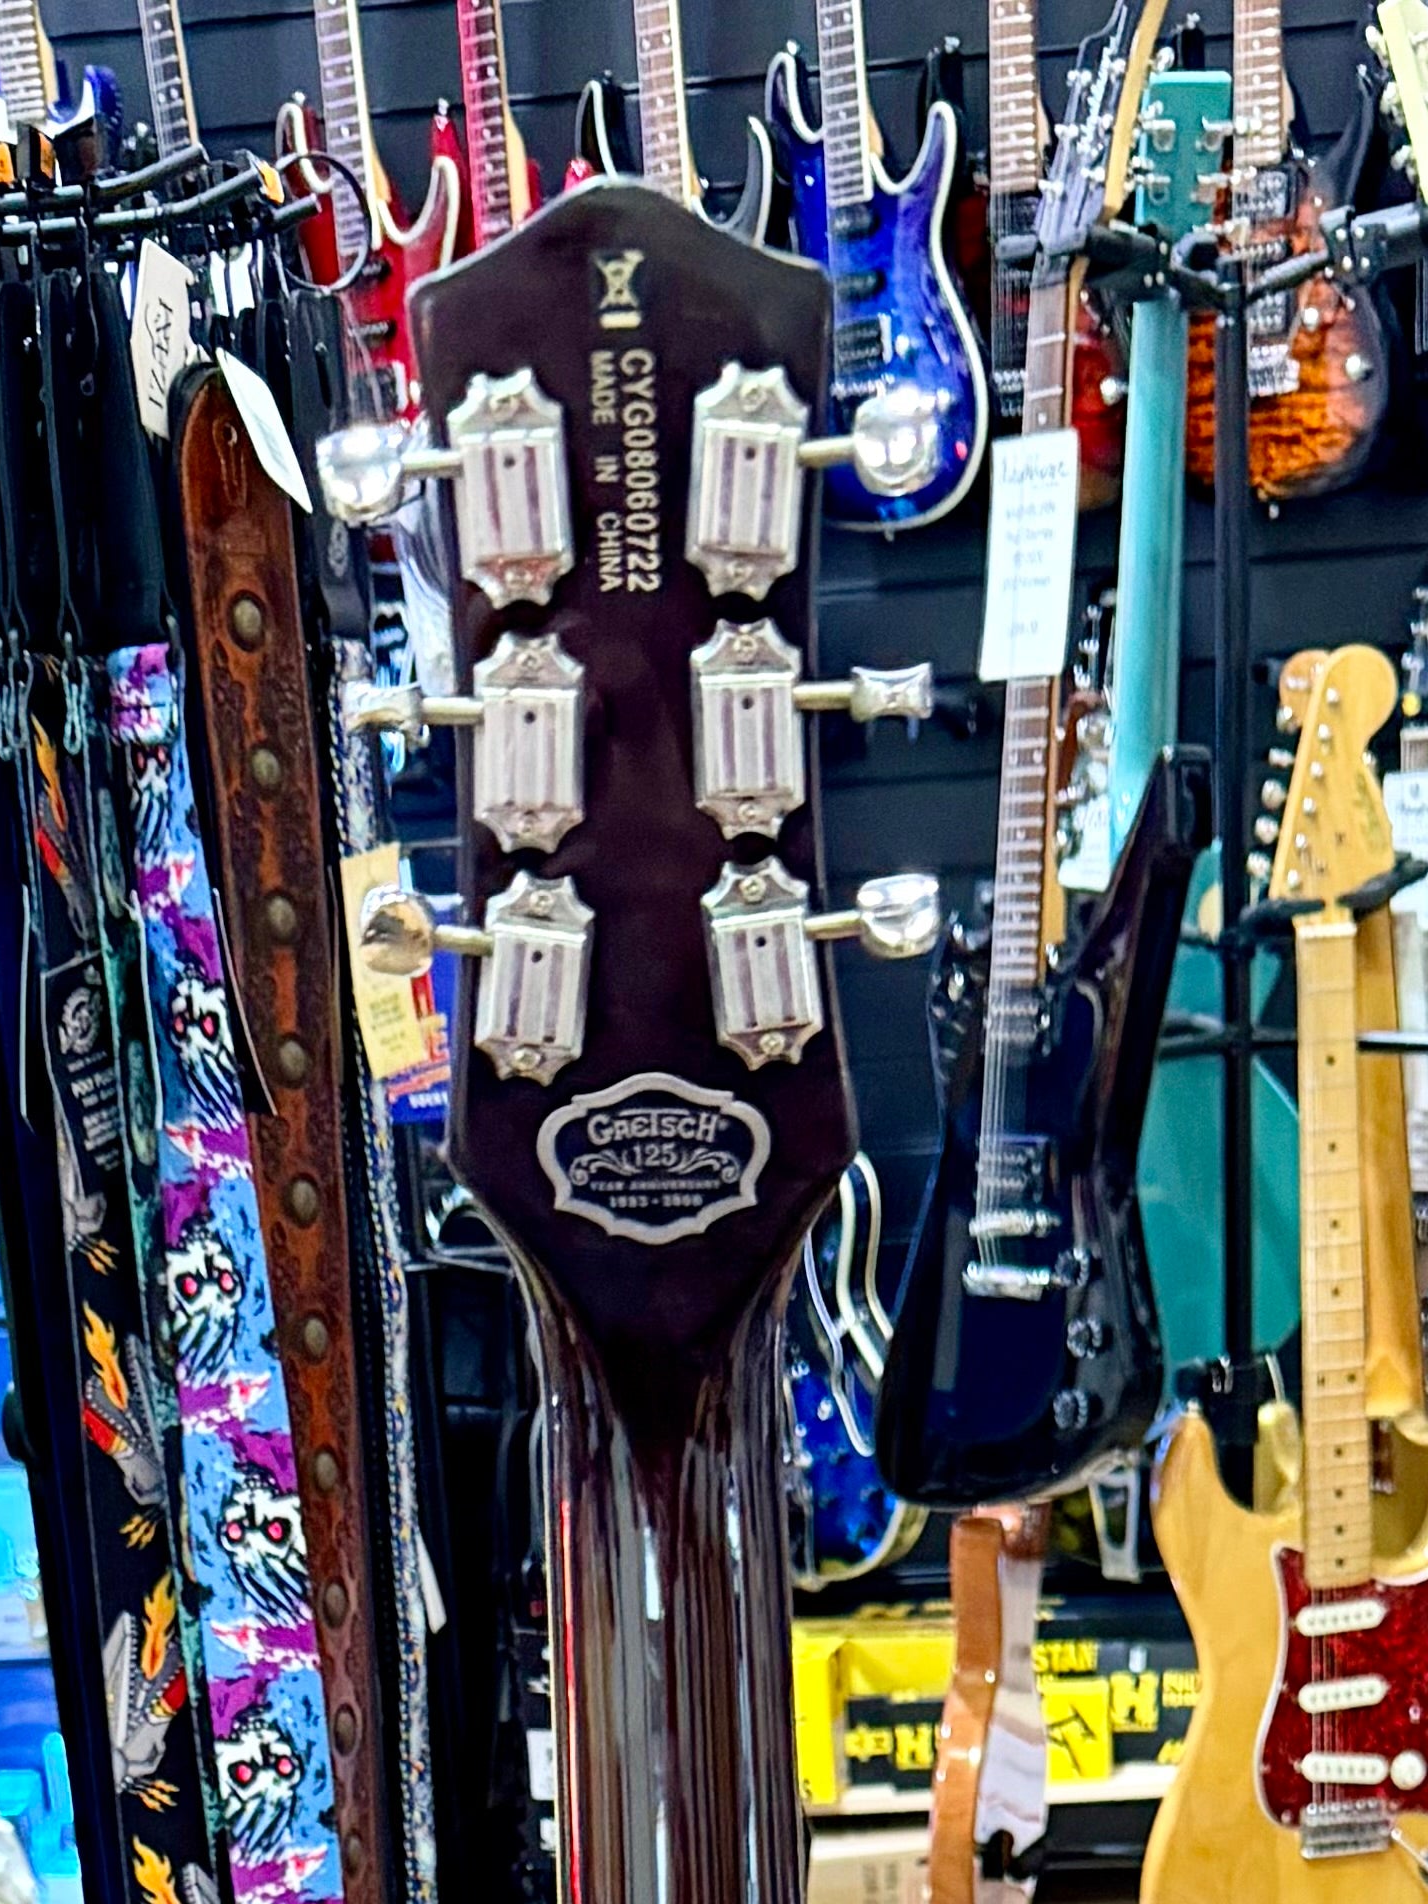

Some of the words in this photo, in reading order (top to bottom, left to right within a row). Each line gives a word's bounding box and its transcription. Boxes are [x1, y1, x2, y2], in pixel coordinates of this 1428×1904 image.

[589, 350, 616, 425] MADE
[594, 455, 620, 484] IN
[619, 348, 661, 593] CYG08060722
[596, 511, 623, 593] CHINA
[587, 1108, 719, 1146] GRETSCH
[632, 1142, 677, 1167] 125
